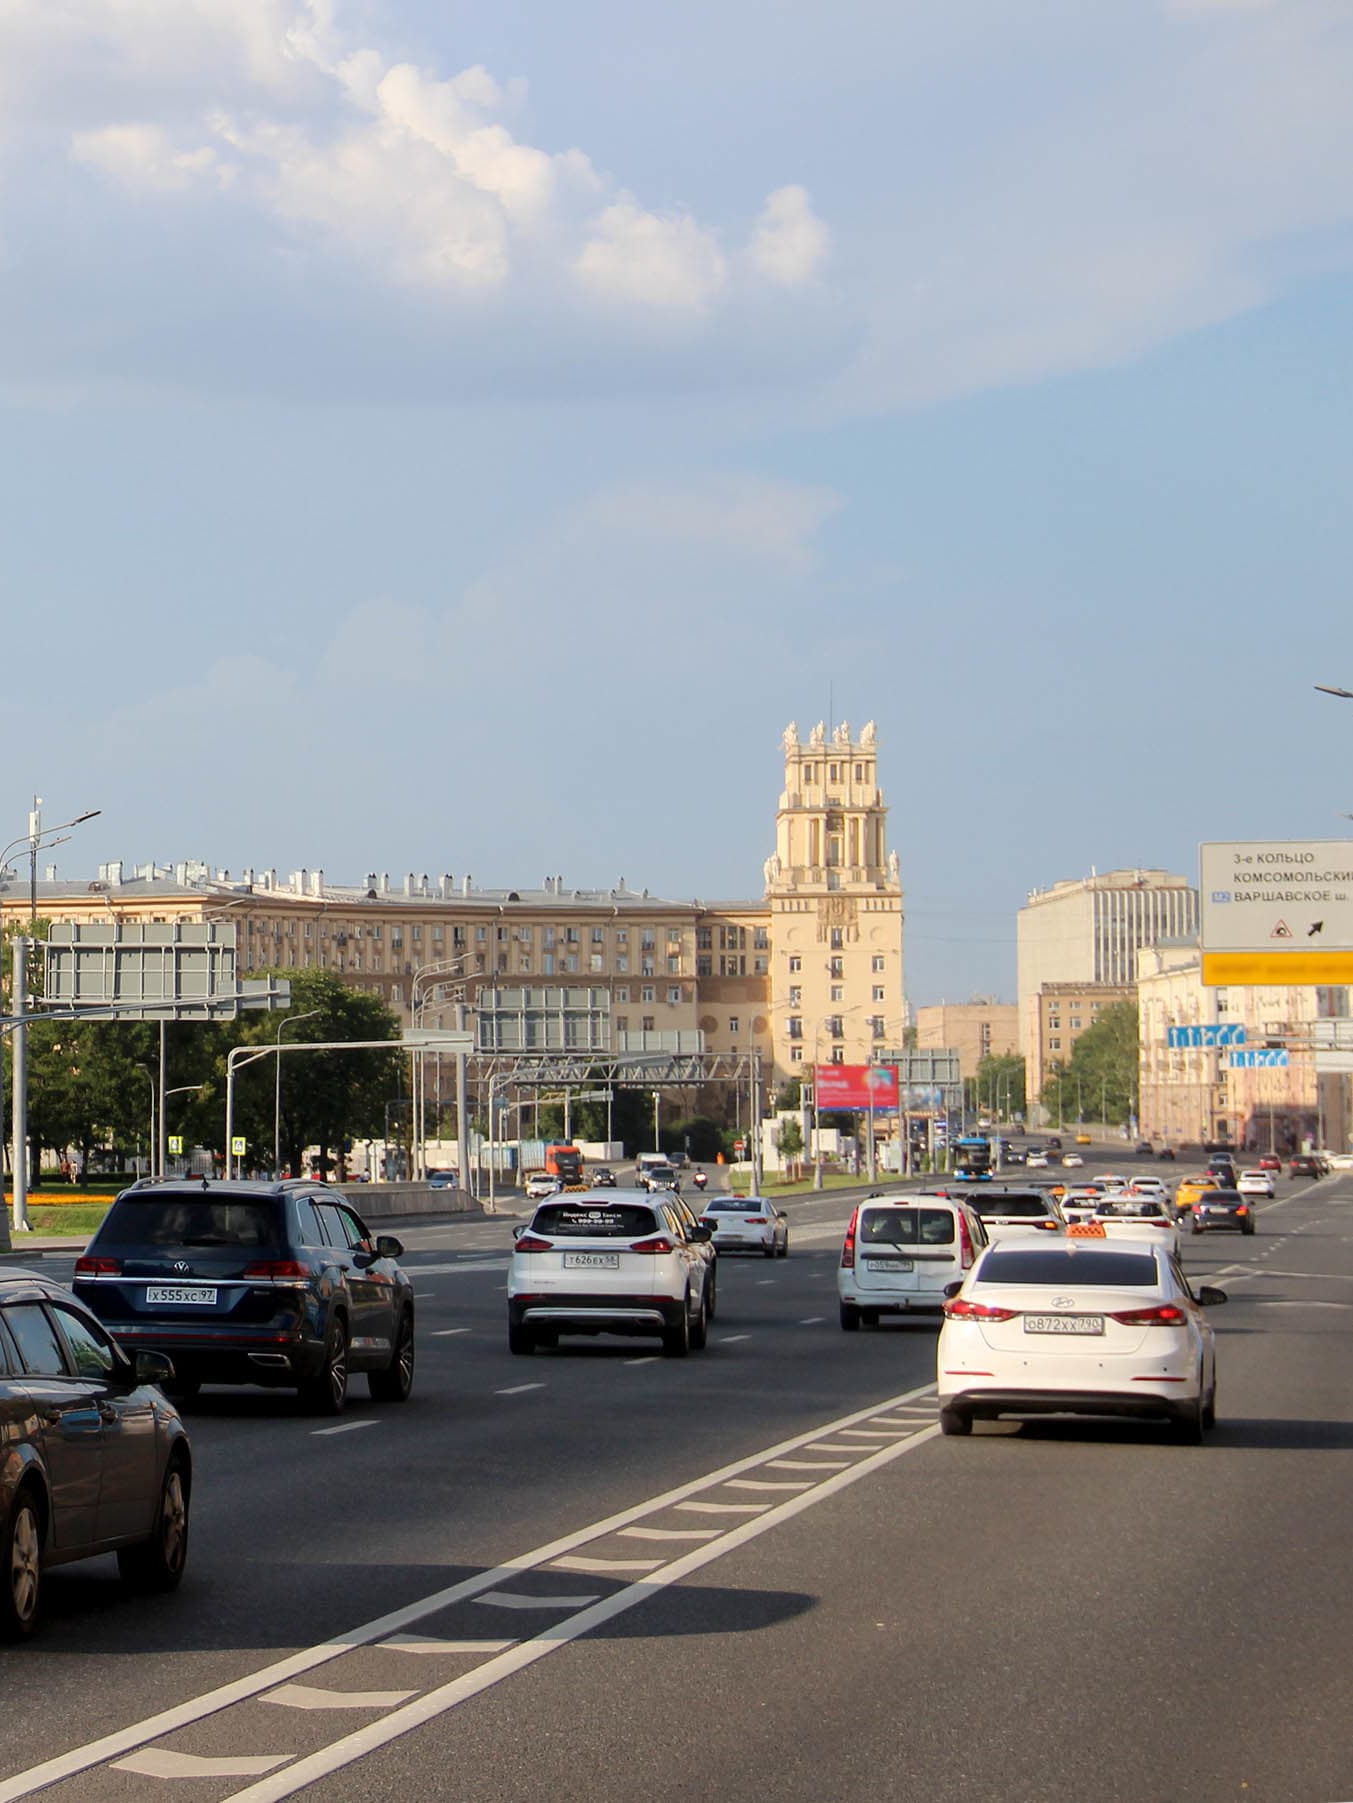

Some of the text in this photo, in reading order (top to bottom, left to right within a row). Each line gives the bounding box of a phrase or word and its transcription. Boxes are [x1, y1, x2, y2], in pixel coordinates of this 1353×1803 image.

[1256, 852, 1314, 865] КОЛЬЦО
[1233, 870, 1353, 883] КОМСОМОЛЬСКИ
[1234, 889, 1330, 902] ВАРШАВСКОЕ
